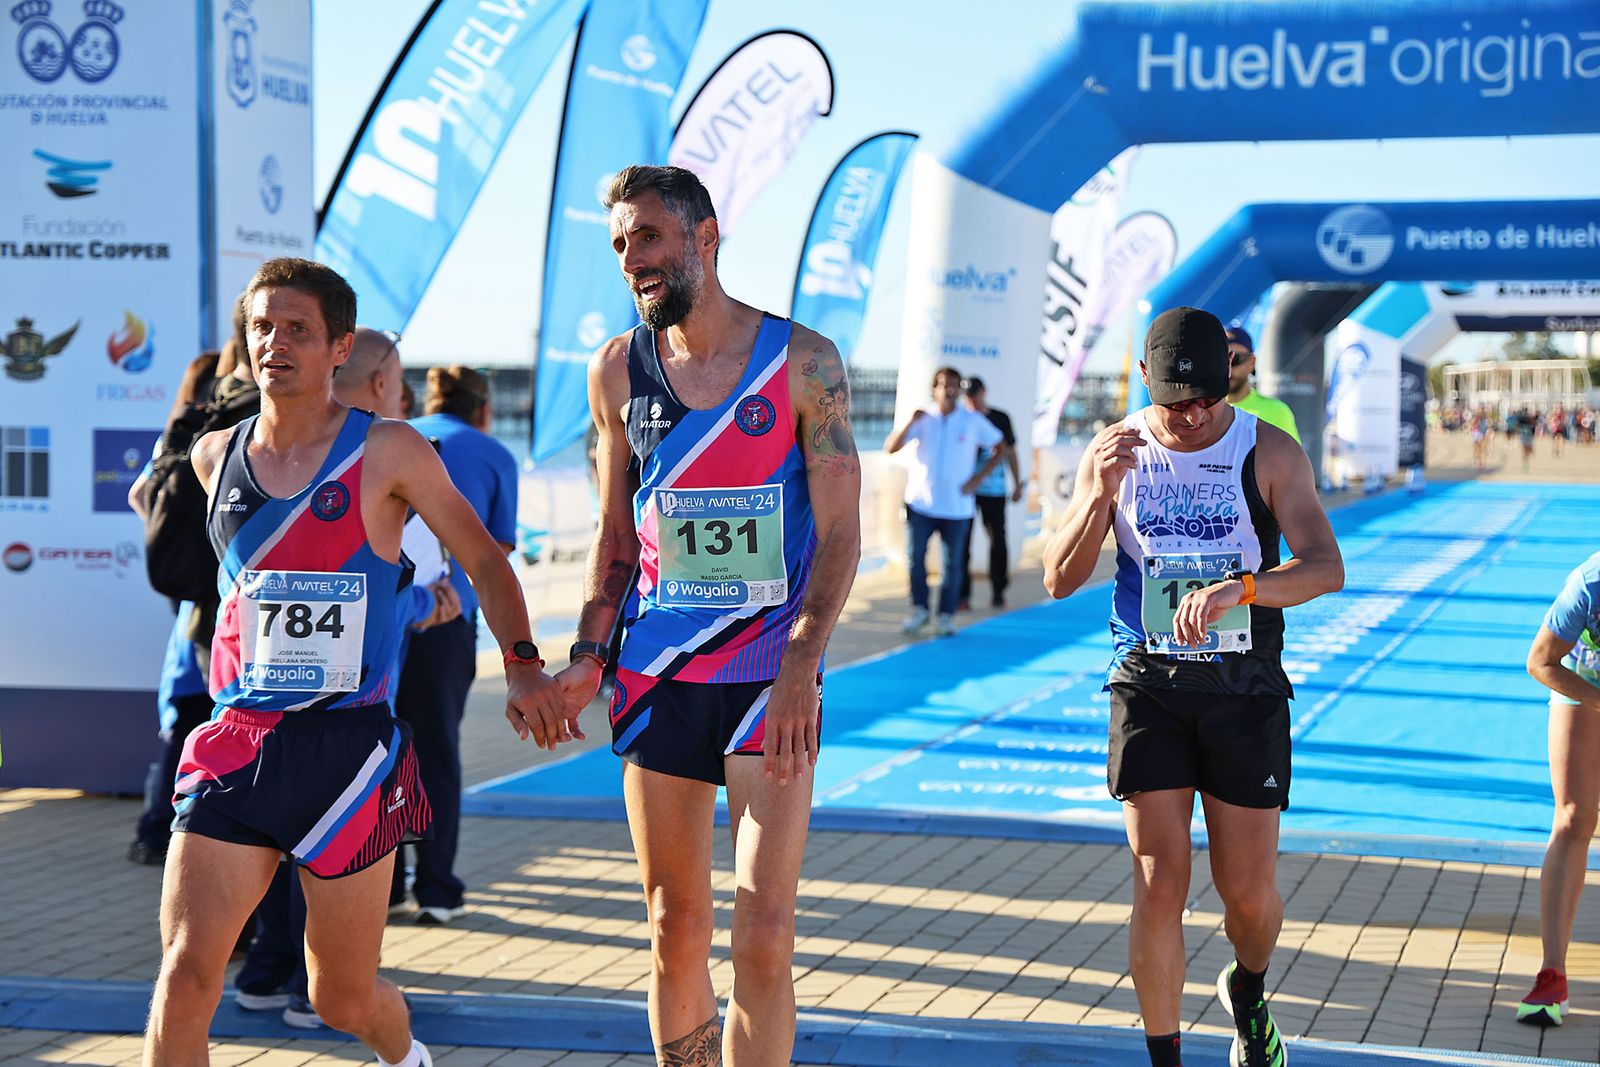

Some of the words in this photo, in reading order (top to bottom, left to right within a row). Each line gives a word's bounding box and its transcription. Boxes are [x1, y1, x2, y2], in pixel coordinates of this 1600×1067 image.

[417, 0, 536, 124] HUELV
[1138, 28, 1366, 92] Huelva
[261, 73, 309, 105] HUELVA
[73, 94, 168, 110] PROVINCIAL
[46, 112, 107, 126] HUELVA
[345, 98, 441, 222] 10
[828, 166, 874, 243] HUELVA
[22, 214, 126, 238] Fundación
[1406, 226, 1491, 250] Puerto
[1496, 223, 1530, 249] de
[89, 239, 170, 260] COPPER
[640, 420, 672, 429] VIATOR
[676, 498, 705, 508] HUELVA
[708, 497, 751, 508] AVATEL
[1135, 483, 1237, 501] RUNNERS
[218, 503, 247, 512] VIATOR
[1136, 500, 1154, 524] la
[1159, 488, 1238, 524] Palmera
[677, 519, 758, 556] 131
[291, 581, 334, 591] AVATEL
[680, 581, 739, 599] Wayalia
[259, 603, 344, 638] 784
[256, 666, 316, 683] Wayalia
